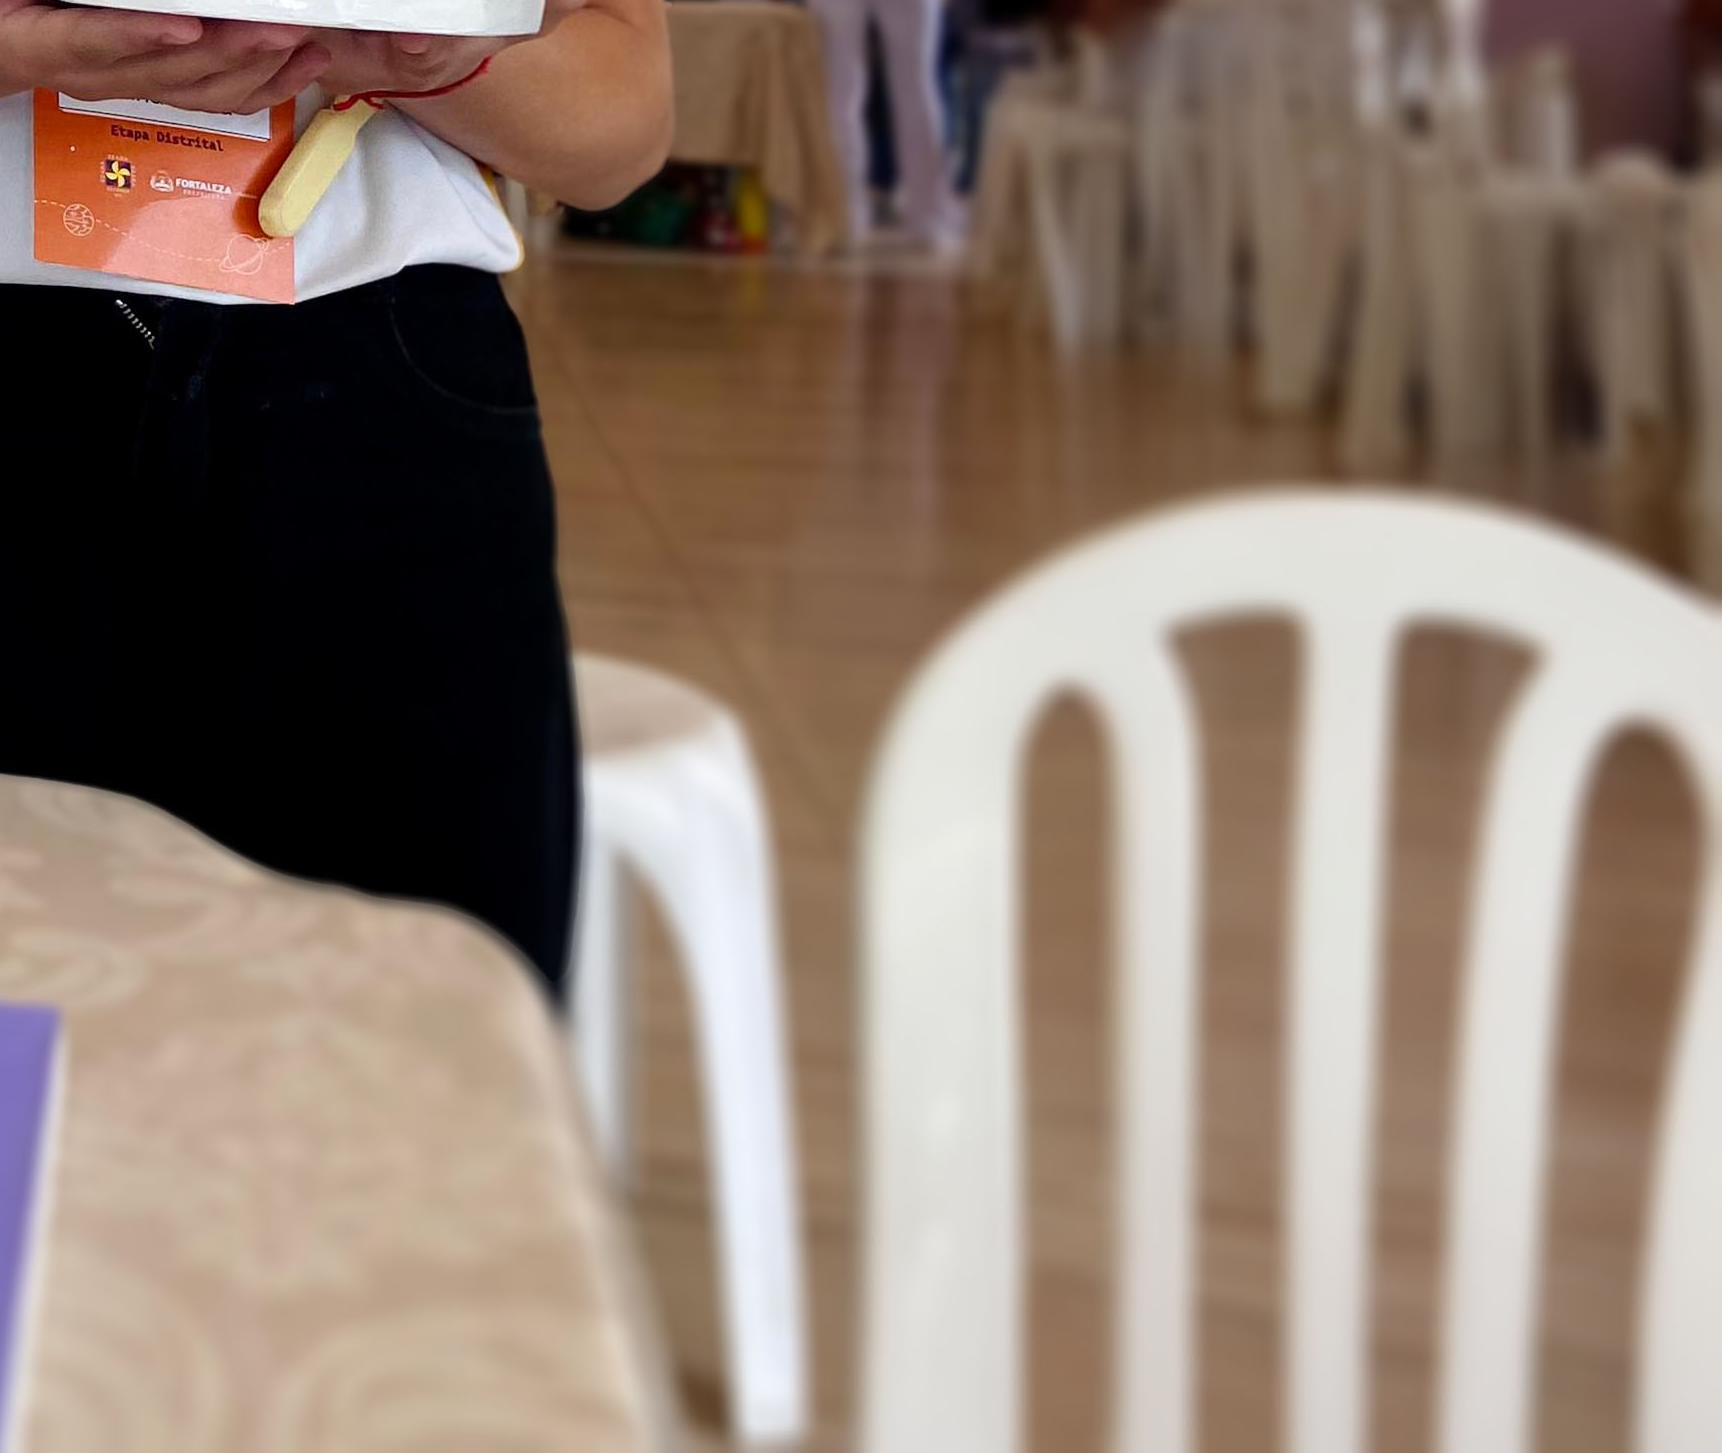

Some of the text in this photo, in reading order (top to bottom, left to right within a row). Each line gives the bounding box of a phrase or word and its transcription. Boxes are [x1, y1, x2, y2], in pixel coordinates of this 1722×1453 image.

[111, 124, 224, 153] Etapa Distrital
[175, 178, 232, 195] FORTALEZA
